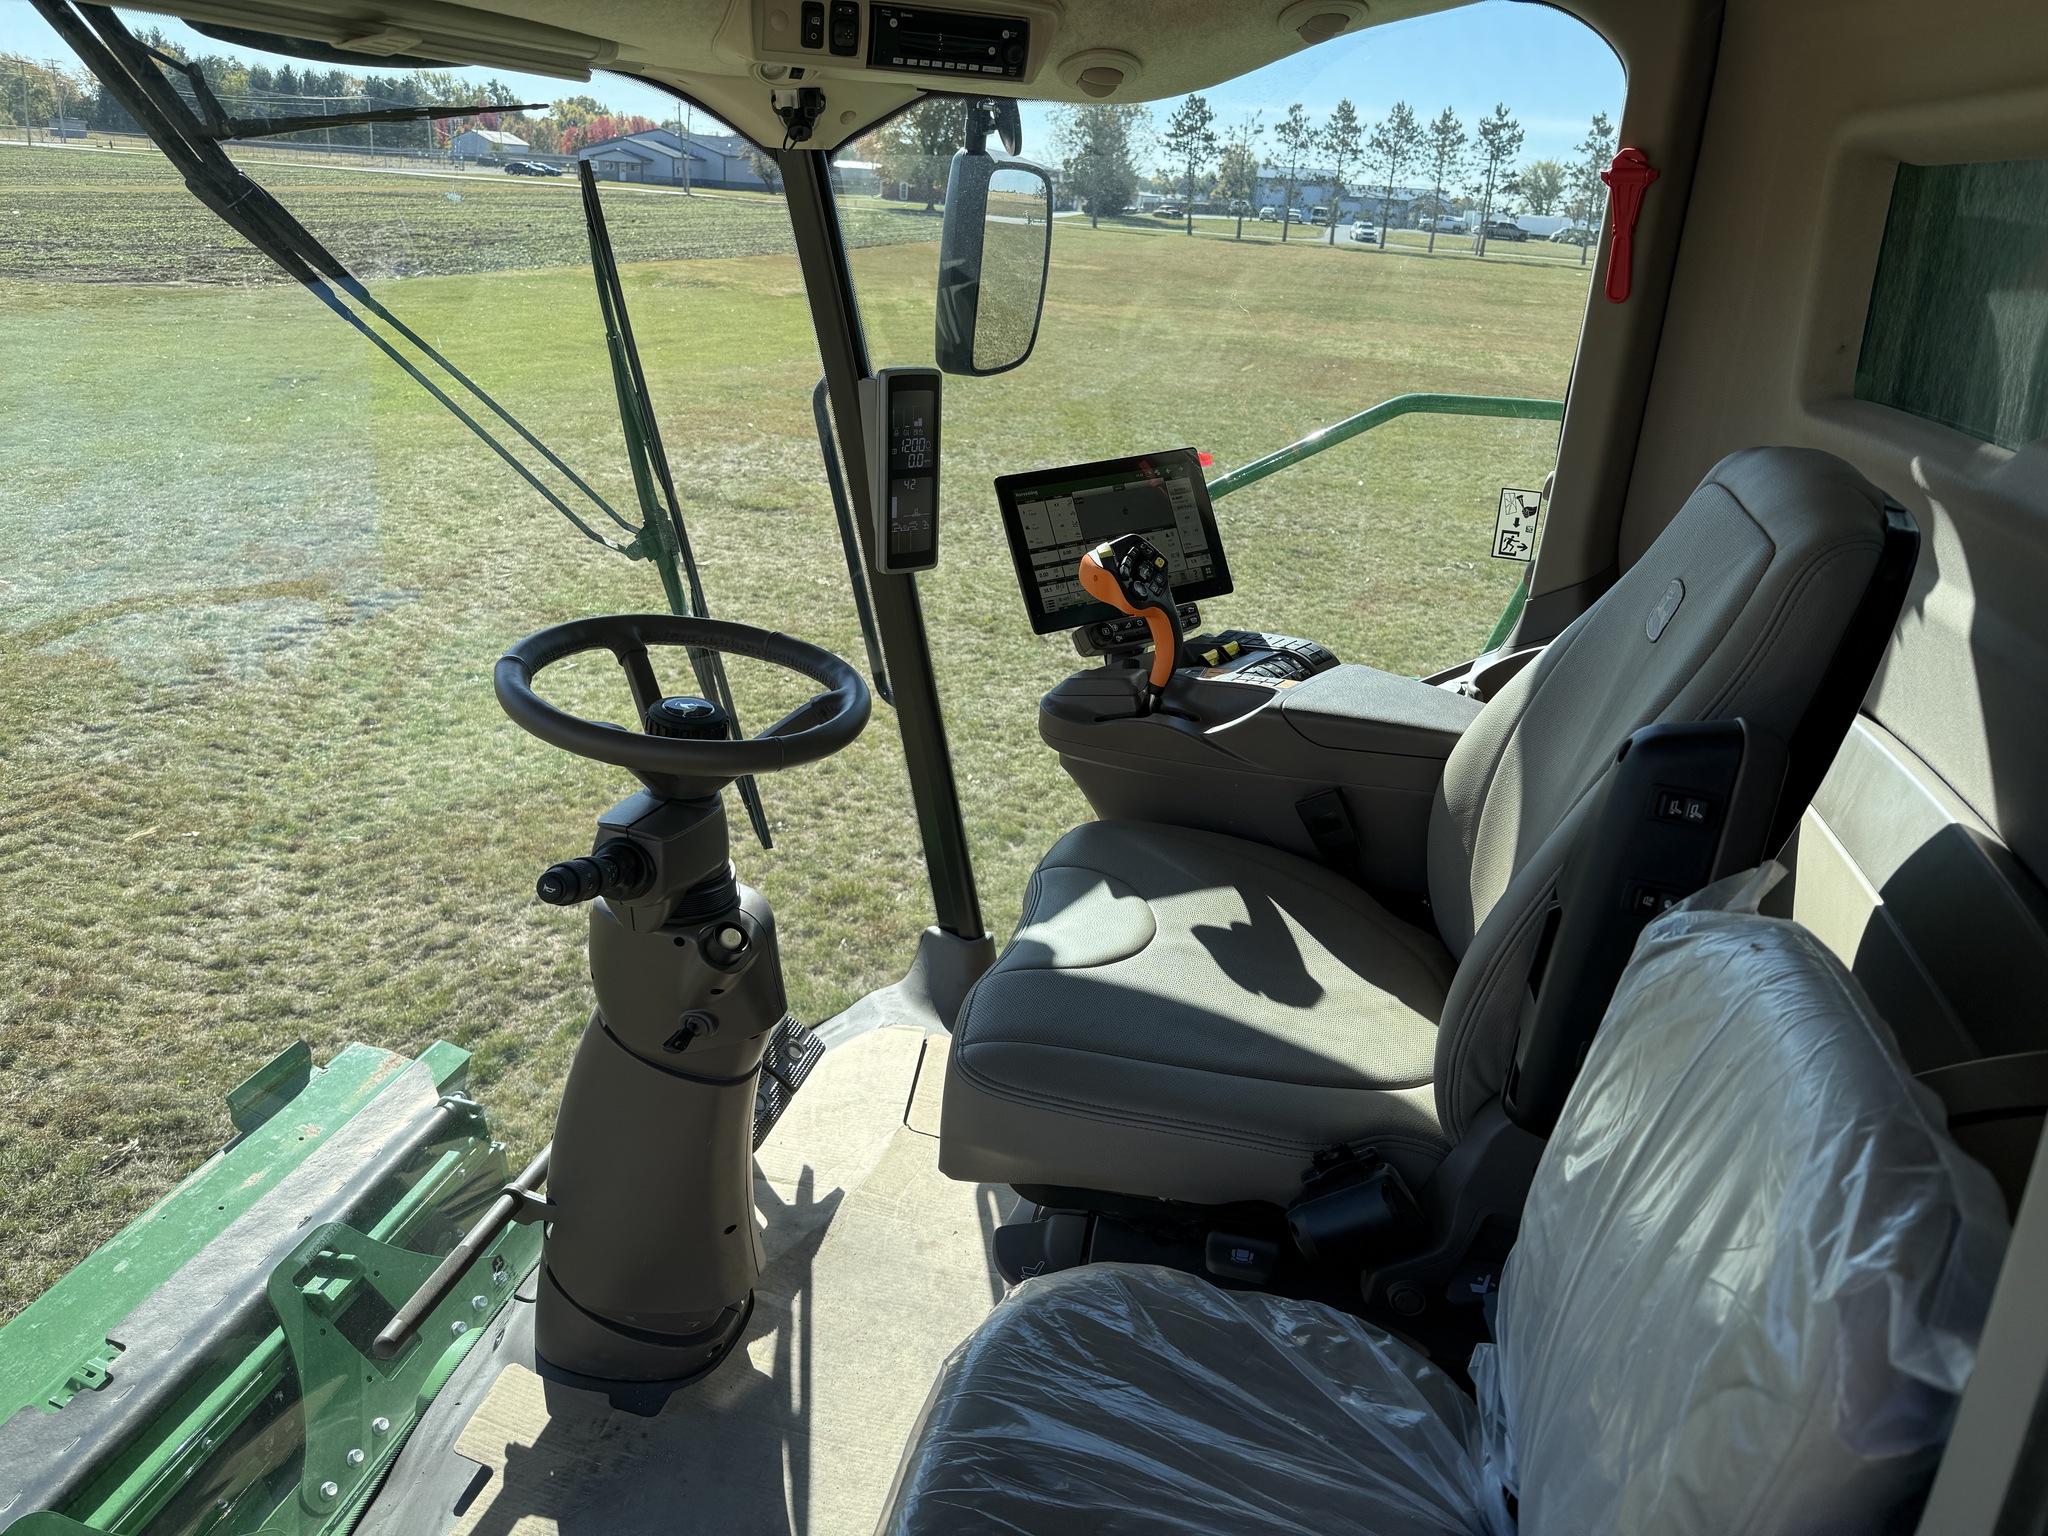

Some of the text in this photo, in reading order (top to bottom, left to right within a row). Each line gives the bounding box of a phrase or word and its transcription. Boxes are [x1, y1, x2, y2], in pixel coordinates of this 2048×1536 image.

[902, 438, 925, 453] 1200
[908, 453, 923, 468] 0.0
[904, 479, 916, 490] 42
